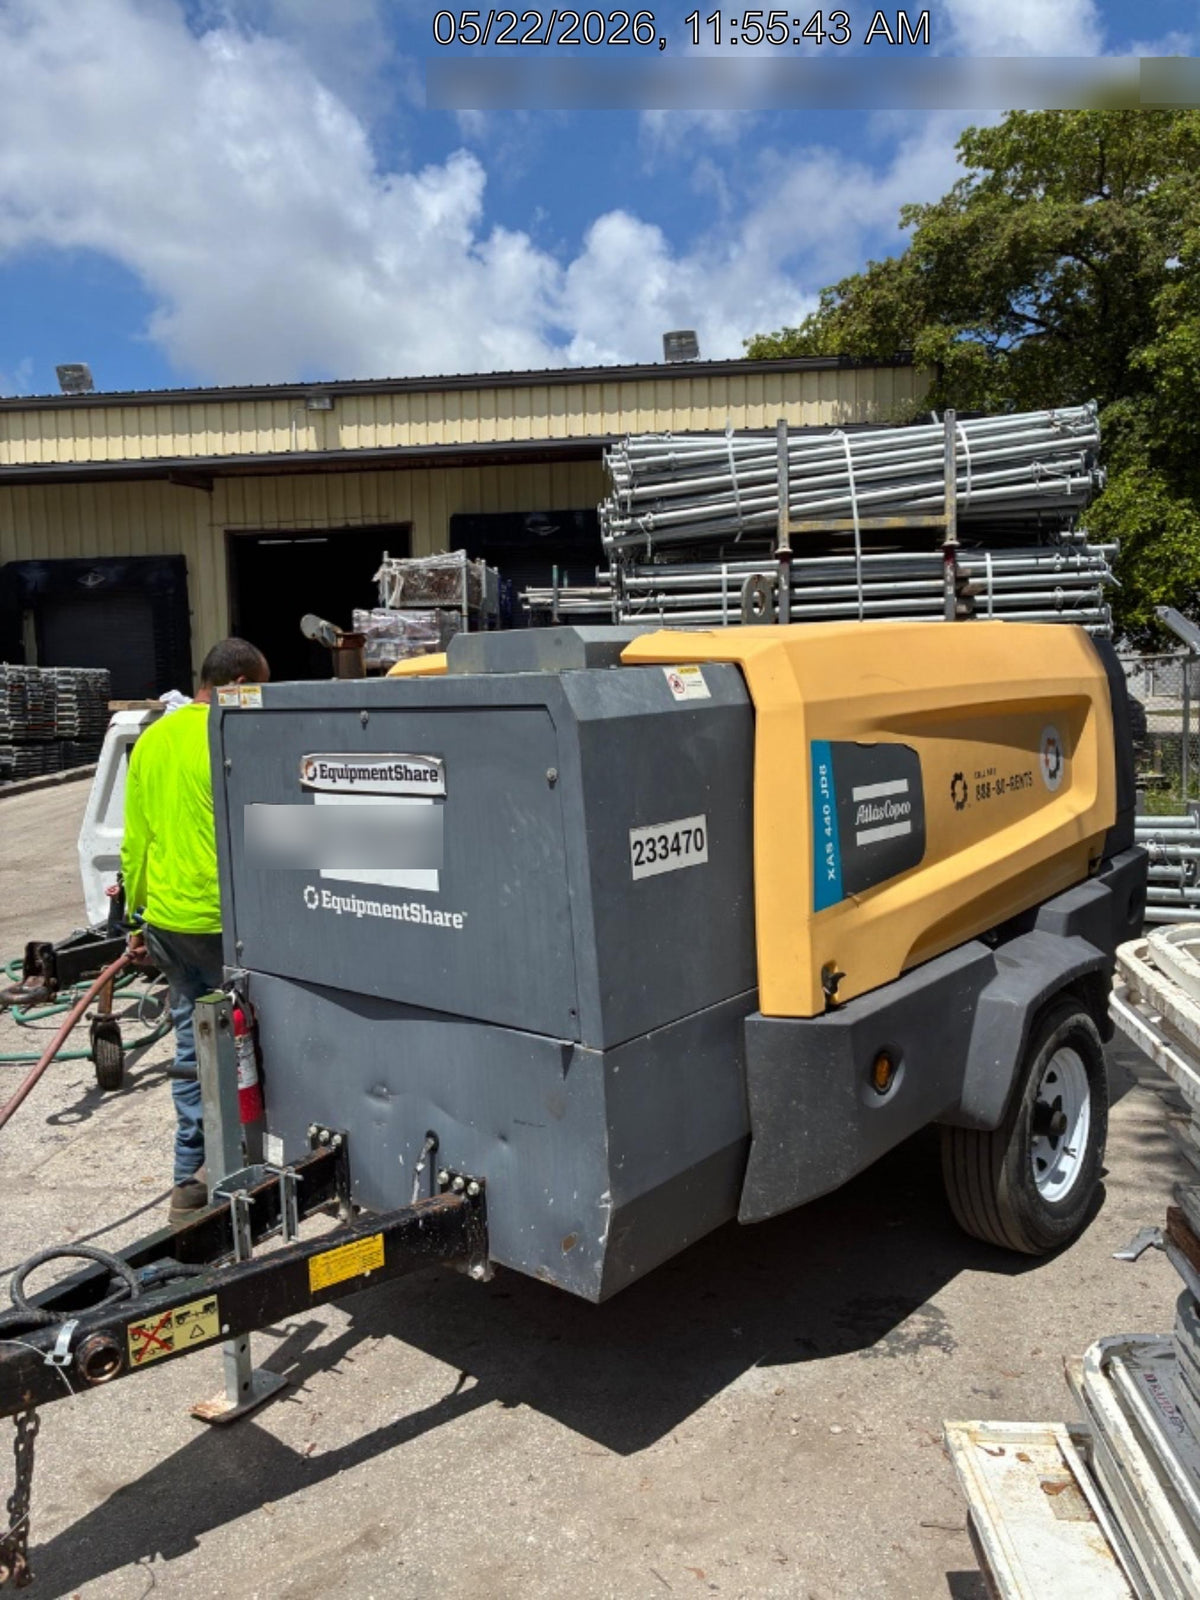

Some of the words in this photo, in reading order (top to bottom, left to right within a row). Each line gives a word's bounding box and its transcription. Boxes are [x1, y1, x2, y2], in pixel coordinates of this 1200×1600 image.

[318, 763, 438, 784] EquipmentShare
[822, 804, 832, 837] 440
[632, 827, 704, 867] 233470
[825, 842, 836, 881] XAS
[320, 889, 464, 929] EquipmentShare
